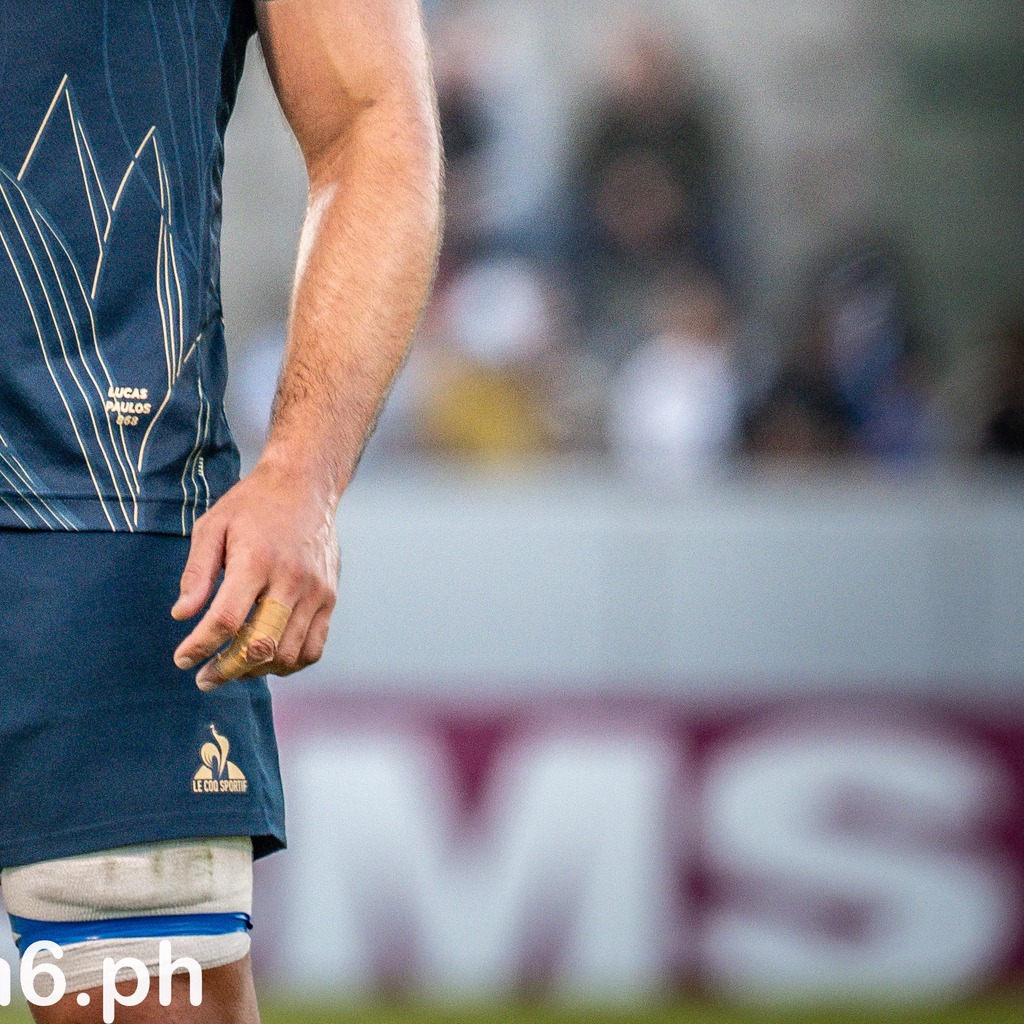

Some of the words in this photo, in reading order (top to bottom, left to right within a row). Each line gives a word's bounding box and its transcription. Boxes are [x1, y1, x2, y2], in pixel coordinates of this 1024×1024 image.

[107, 386, 148, 400] LUCAS
[105, 400, 152, 414] PAULOS
[192, 779, 203, 793] LE
[203, 779, 219, 793] COQ
[219, 779, 248, 793] SPORTIF
